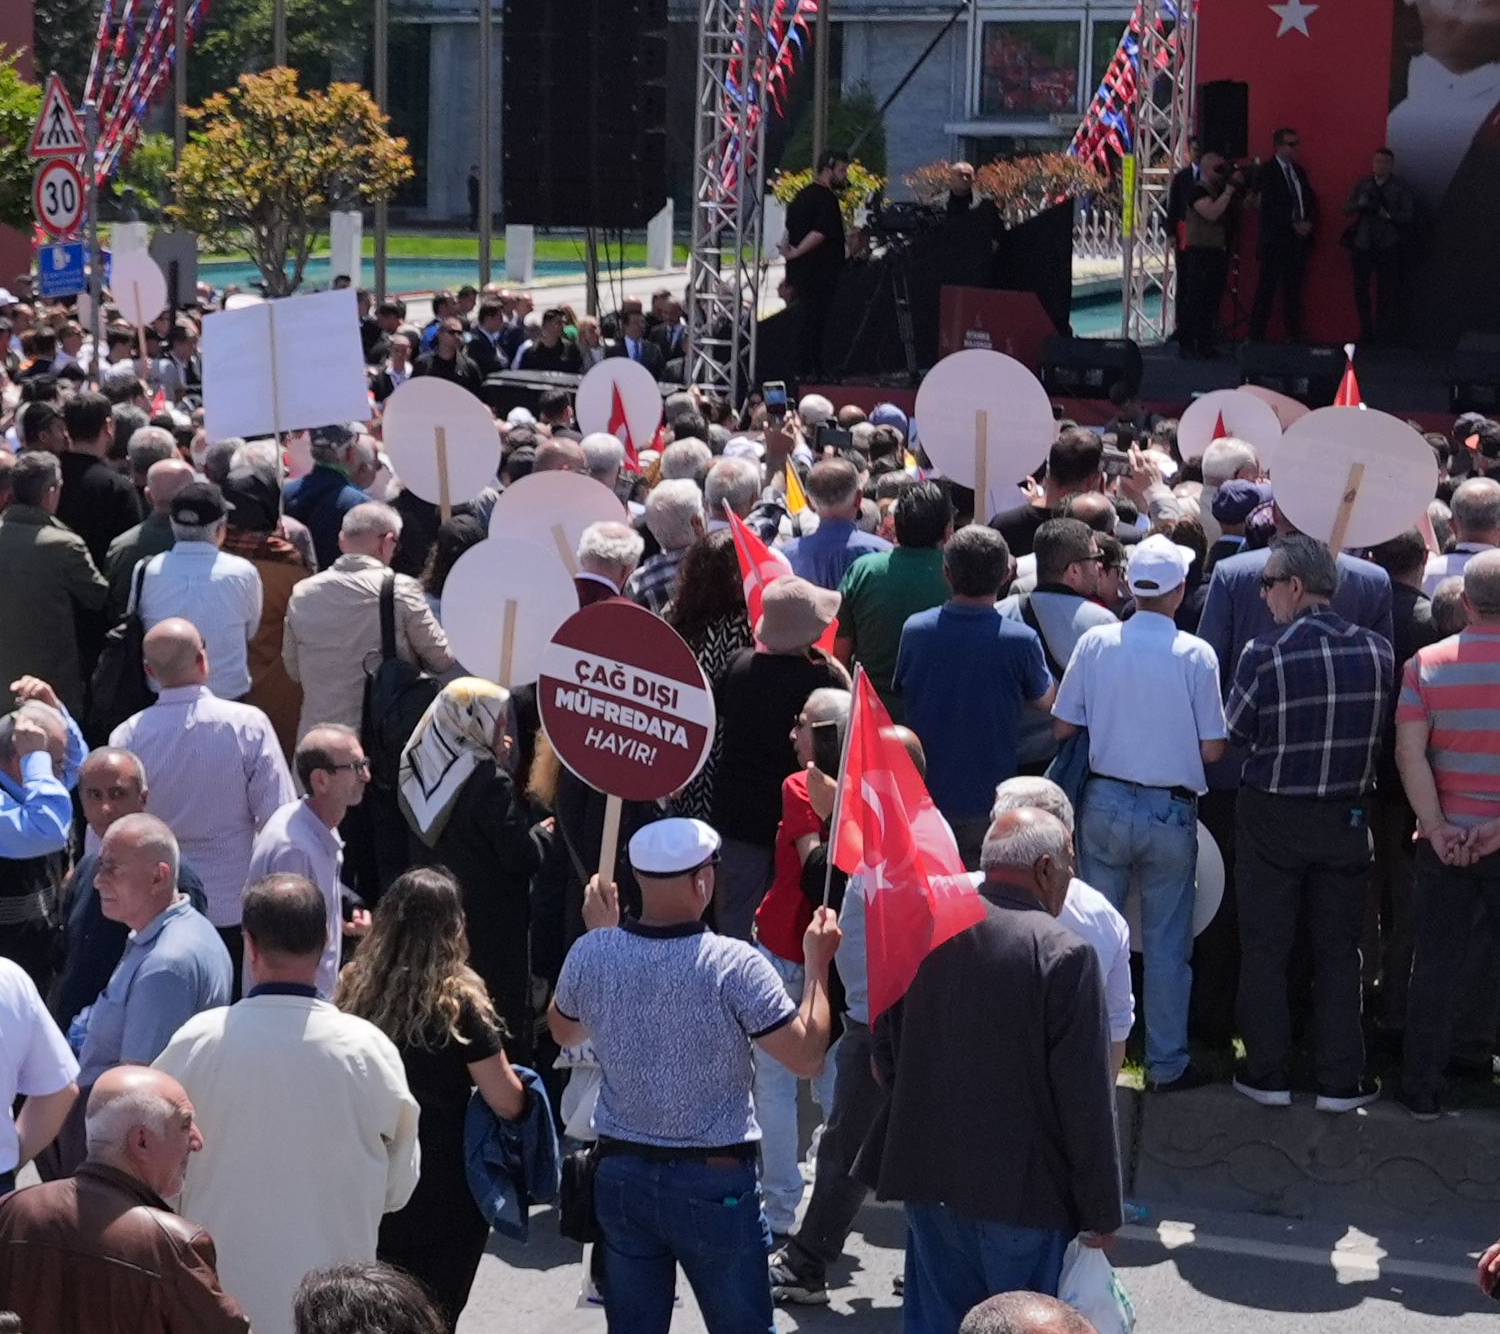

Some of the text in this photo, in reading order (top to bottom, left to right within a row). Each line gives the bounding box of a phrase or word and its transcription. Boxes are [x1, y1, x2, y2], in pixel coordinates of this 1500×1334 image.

[45, 179, 75, 216] 30
[575, 660, 678, 709] ÇAĞ DIŞI
[555, 687, 688, 749] MÜFREDATA
[584, 728, 657, 766] HAYIR!
